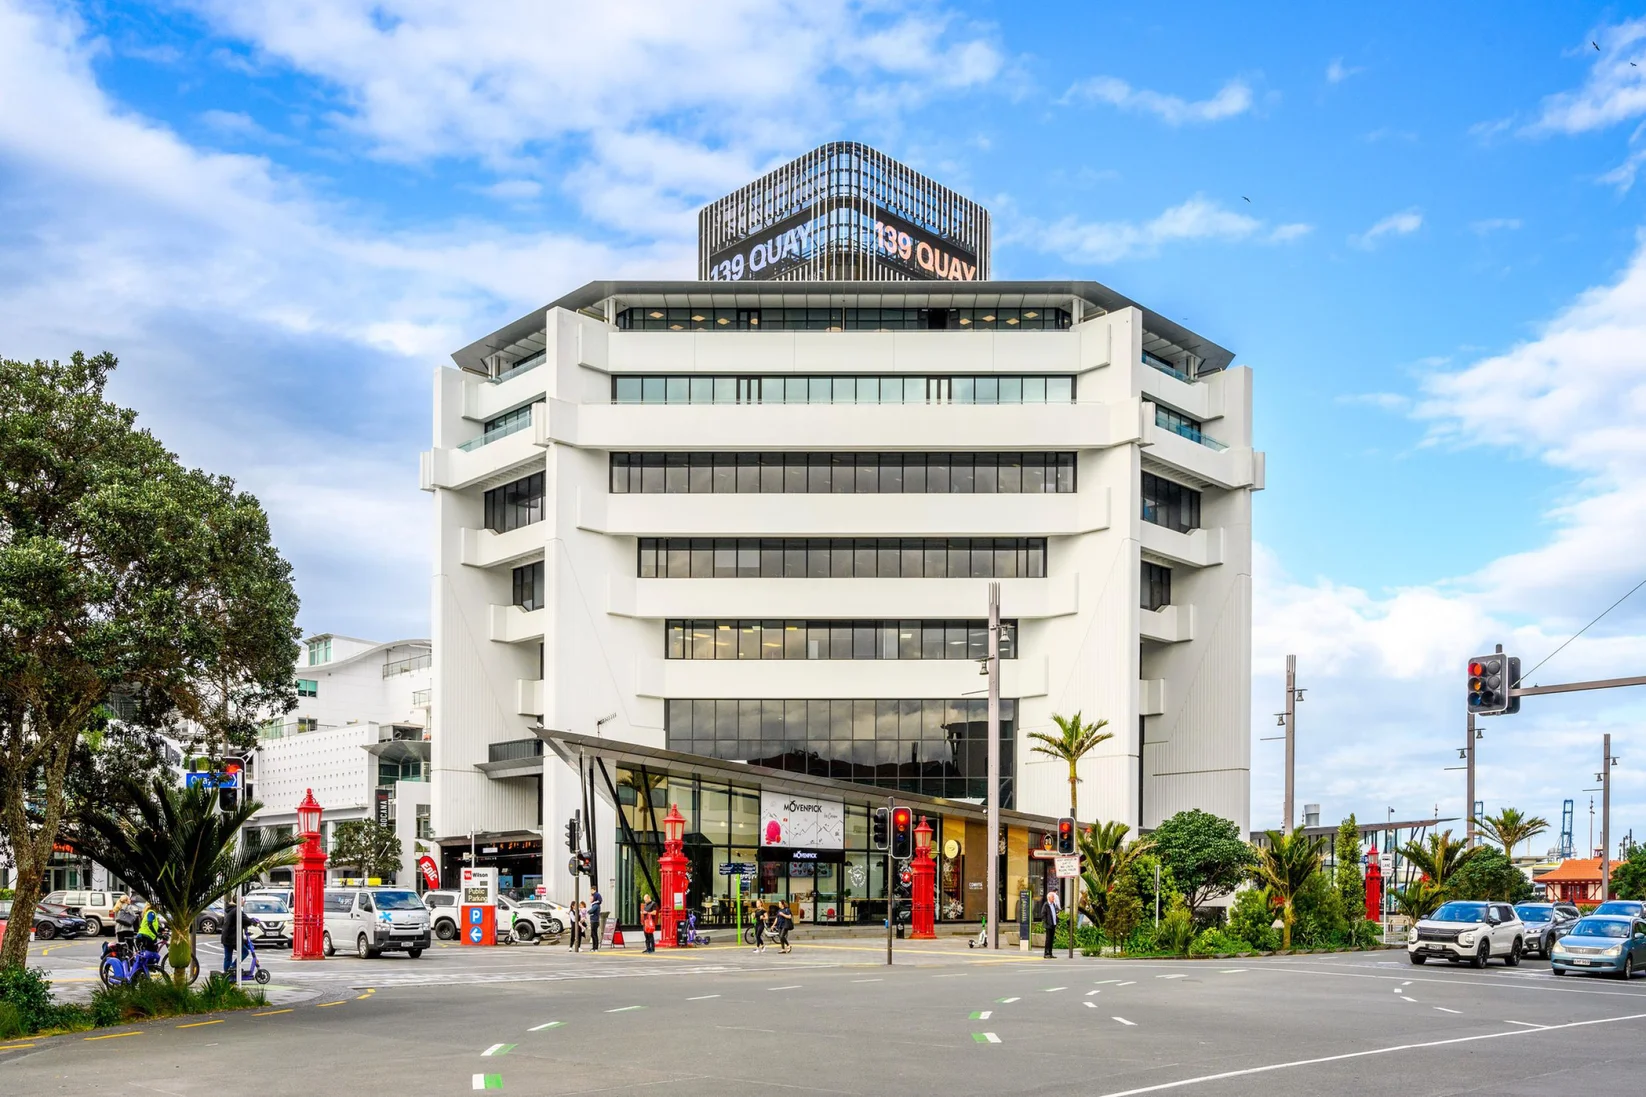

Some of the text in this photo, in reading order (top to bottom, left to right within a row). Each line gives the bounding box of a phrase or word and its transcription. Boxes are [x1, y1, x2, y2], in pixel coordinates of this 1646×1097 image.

[711, 220, 812, 280] 139 QUAY
[874, 221, 976, 280] 139 QUAY
[467, 895, 488, 903] Parking
